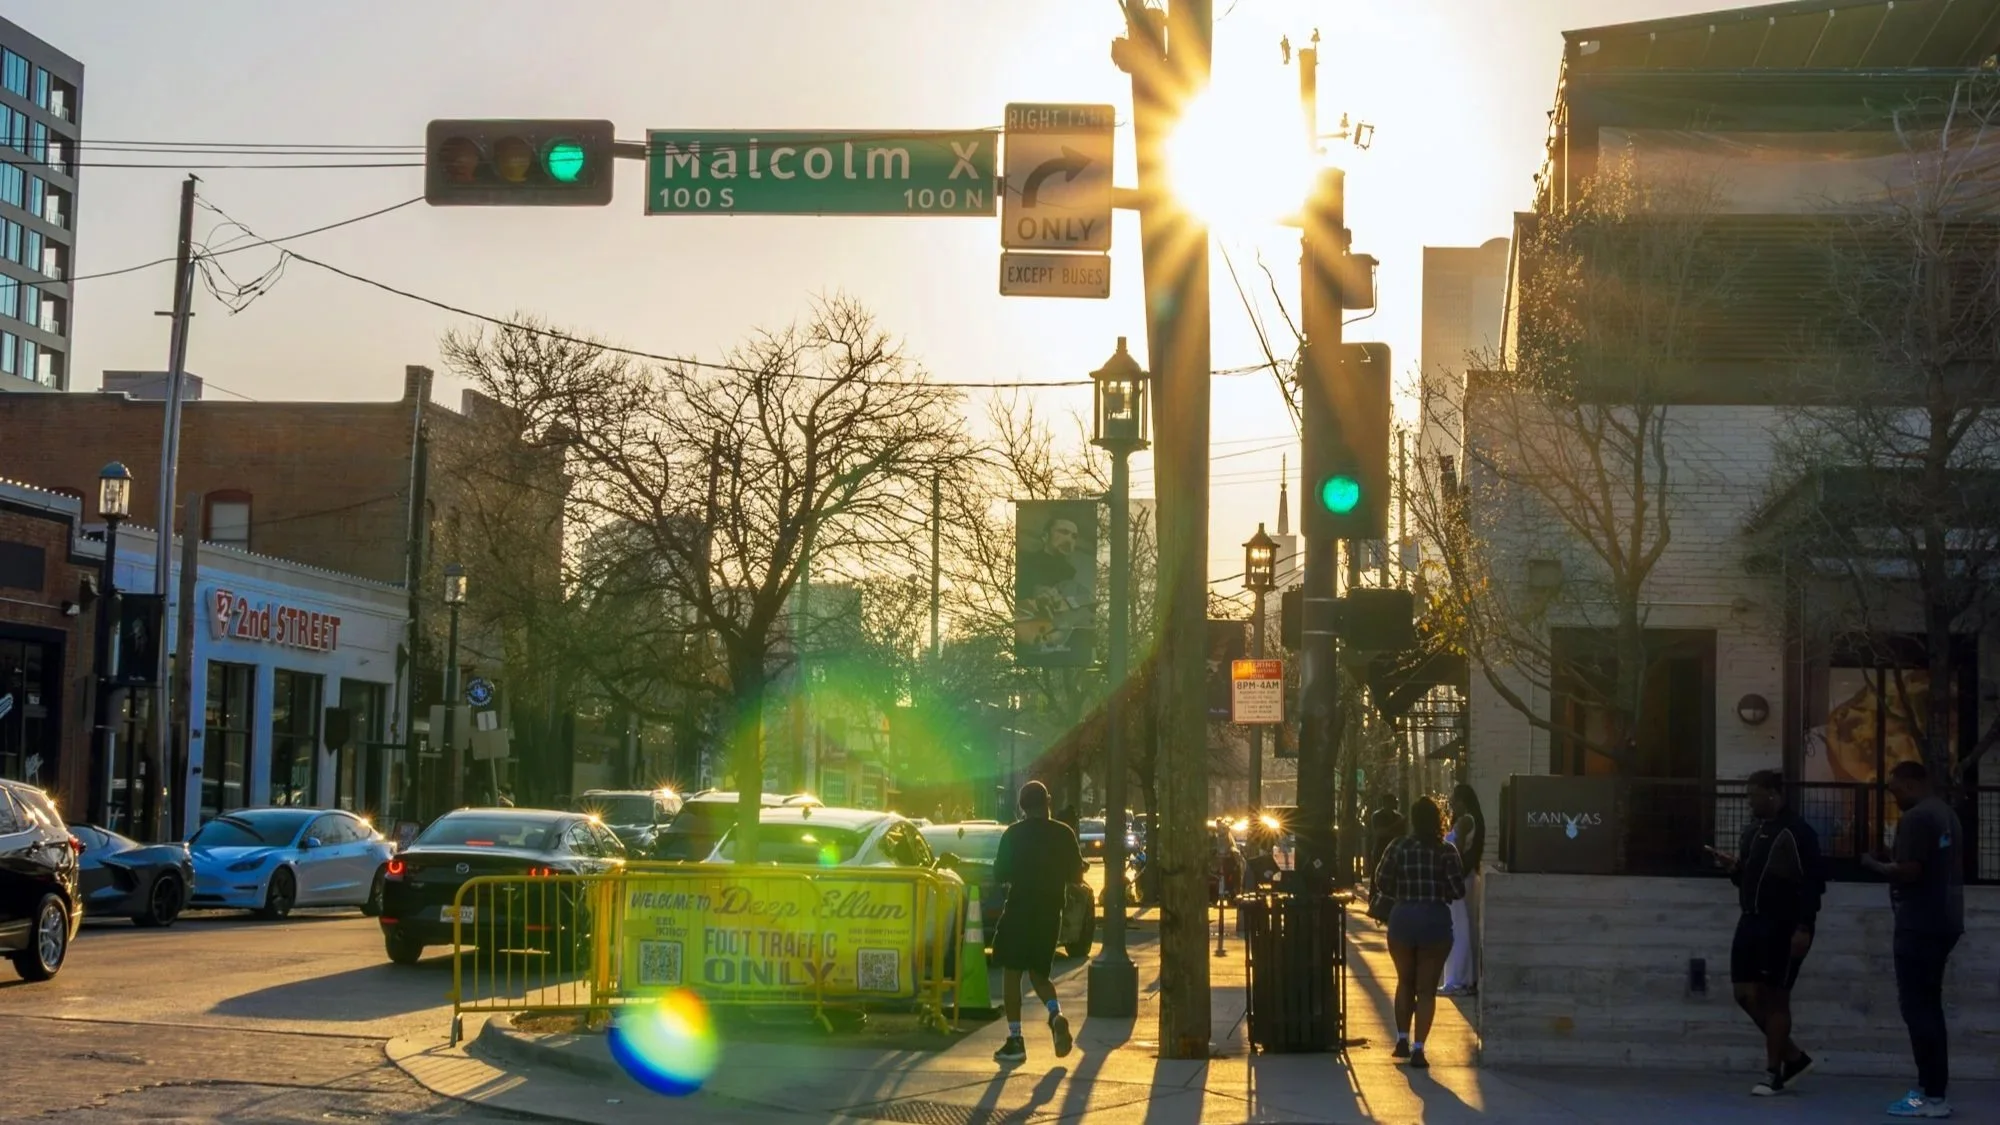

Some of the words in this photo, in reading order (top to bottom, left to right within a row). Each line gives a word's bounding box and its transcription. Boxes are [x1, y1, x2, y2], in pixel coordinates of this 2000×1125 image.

[1009, 109, 1060, 129] RIGHT
[664, 138, 910, 180] Malcolm
[948, 141, 980, 180] X
[659, 188, 711, 208] 100
[719, 188, 735, 208] S
[903, 189, 956, 209] 100
[965, 189, 983, 209] N
[1017, 217, 1095, 241] ONLY
[1008, 266, 1054, 283] EXCEPT
[1062, 268, 1103, 285] BUSES
[236, 597, 271, 641] 2nd
[276, 605, 341, 652] STREET
[1527, 811, 1602, 828] KANVAS
[631, 892, 695, 910] WELCOME
[696, 894, 711, 911] TO
[713, 886, 800, 924] Deep
[812, 889, 908, 919] Ellum
[705, 928, 752, 956] FOOT
[759, 930, 838, 959] TRAFFIC
[704, 958, 836, 986] ONLY
